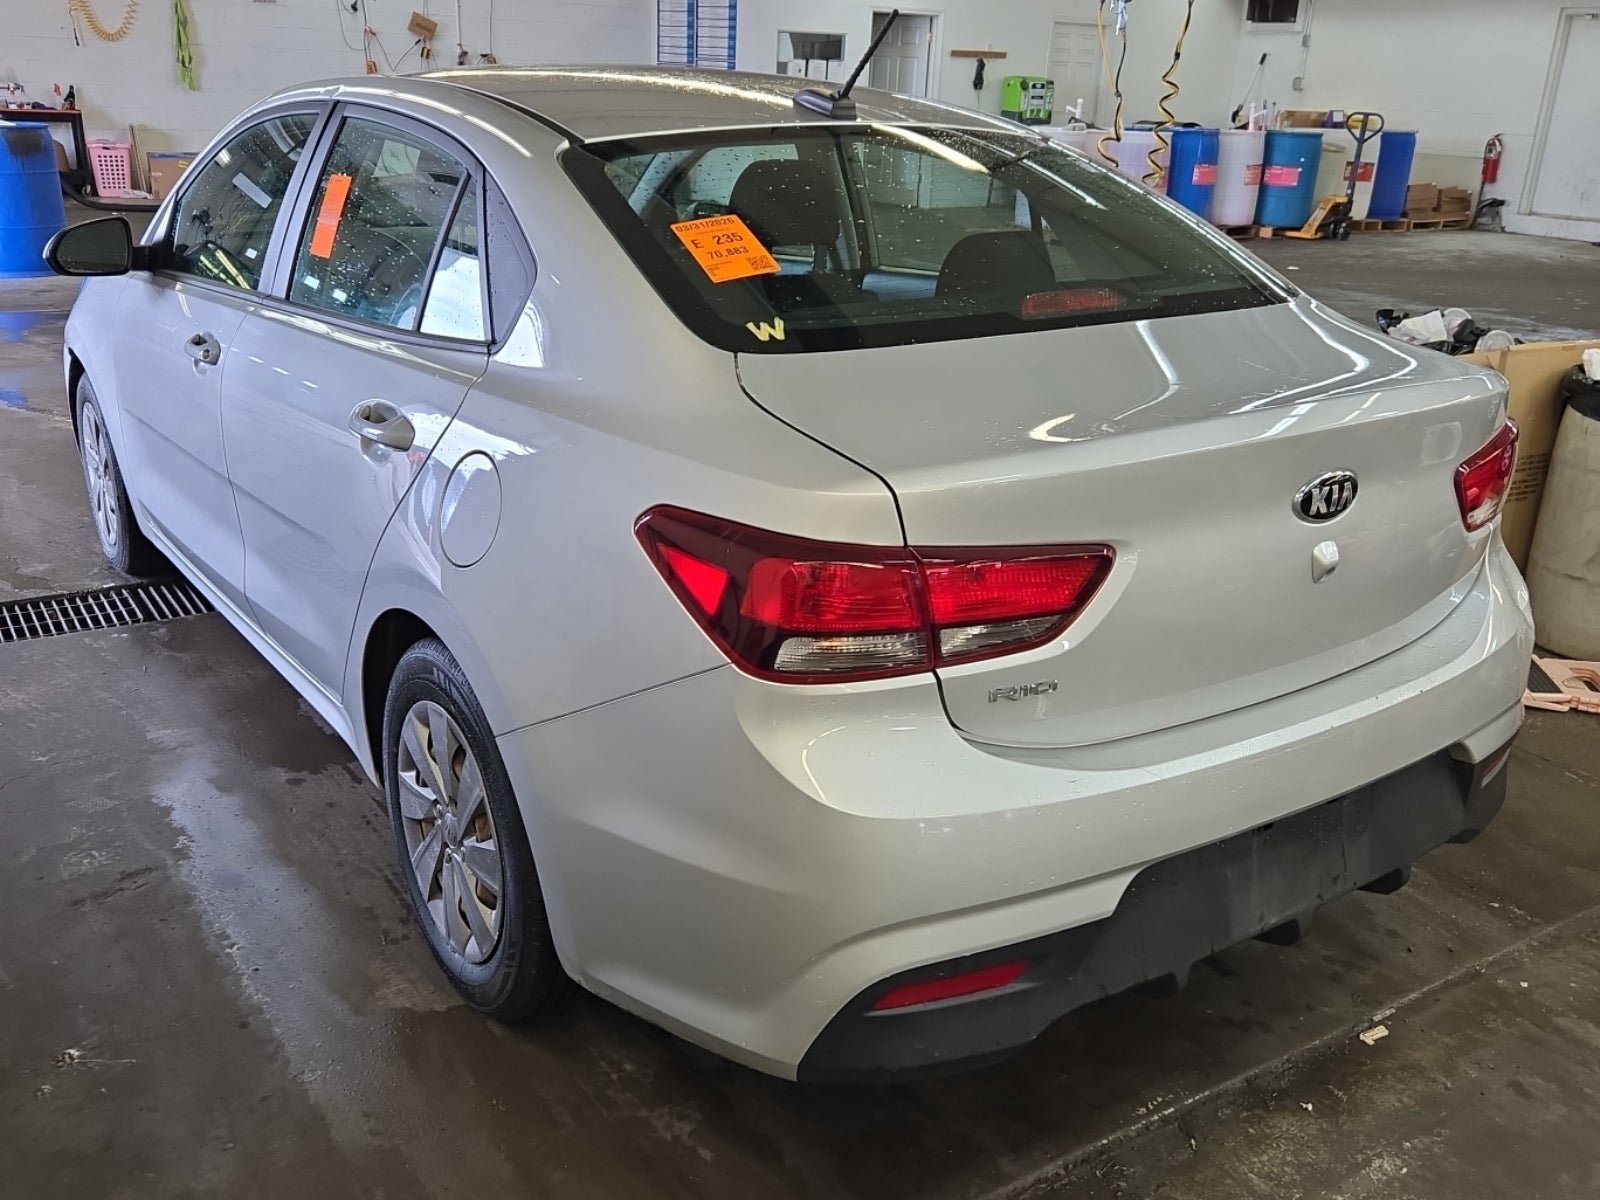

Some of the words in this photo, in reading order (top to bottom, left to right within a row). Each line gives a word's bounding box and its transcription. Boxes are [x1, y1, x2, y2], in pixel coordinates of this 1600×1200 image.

[675, 217, 735, 233] 03/31/2026
[691, 239, 704, 249] E
[712, 232, 744, 245] 235
[706, 246, 749, 259] 70,883
[745, 316, 785, 341] W
[1310, 481, 1352, 515] KIA
[987, 679, 1058, 703] RIO
